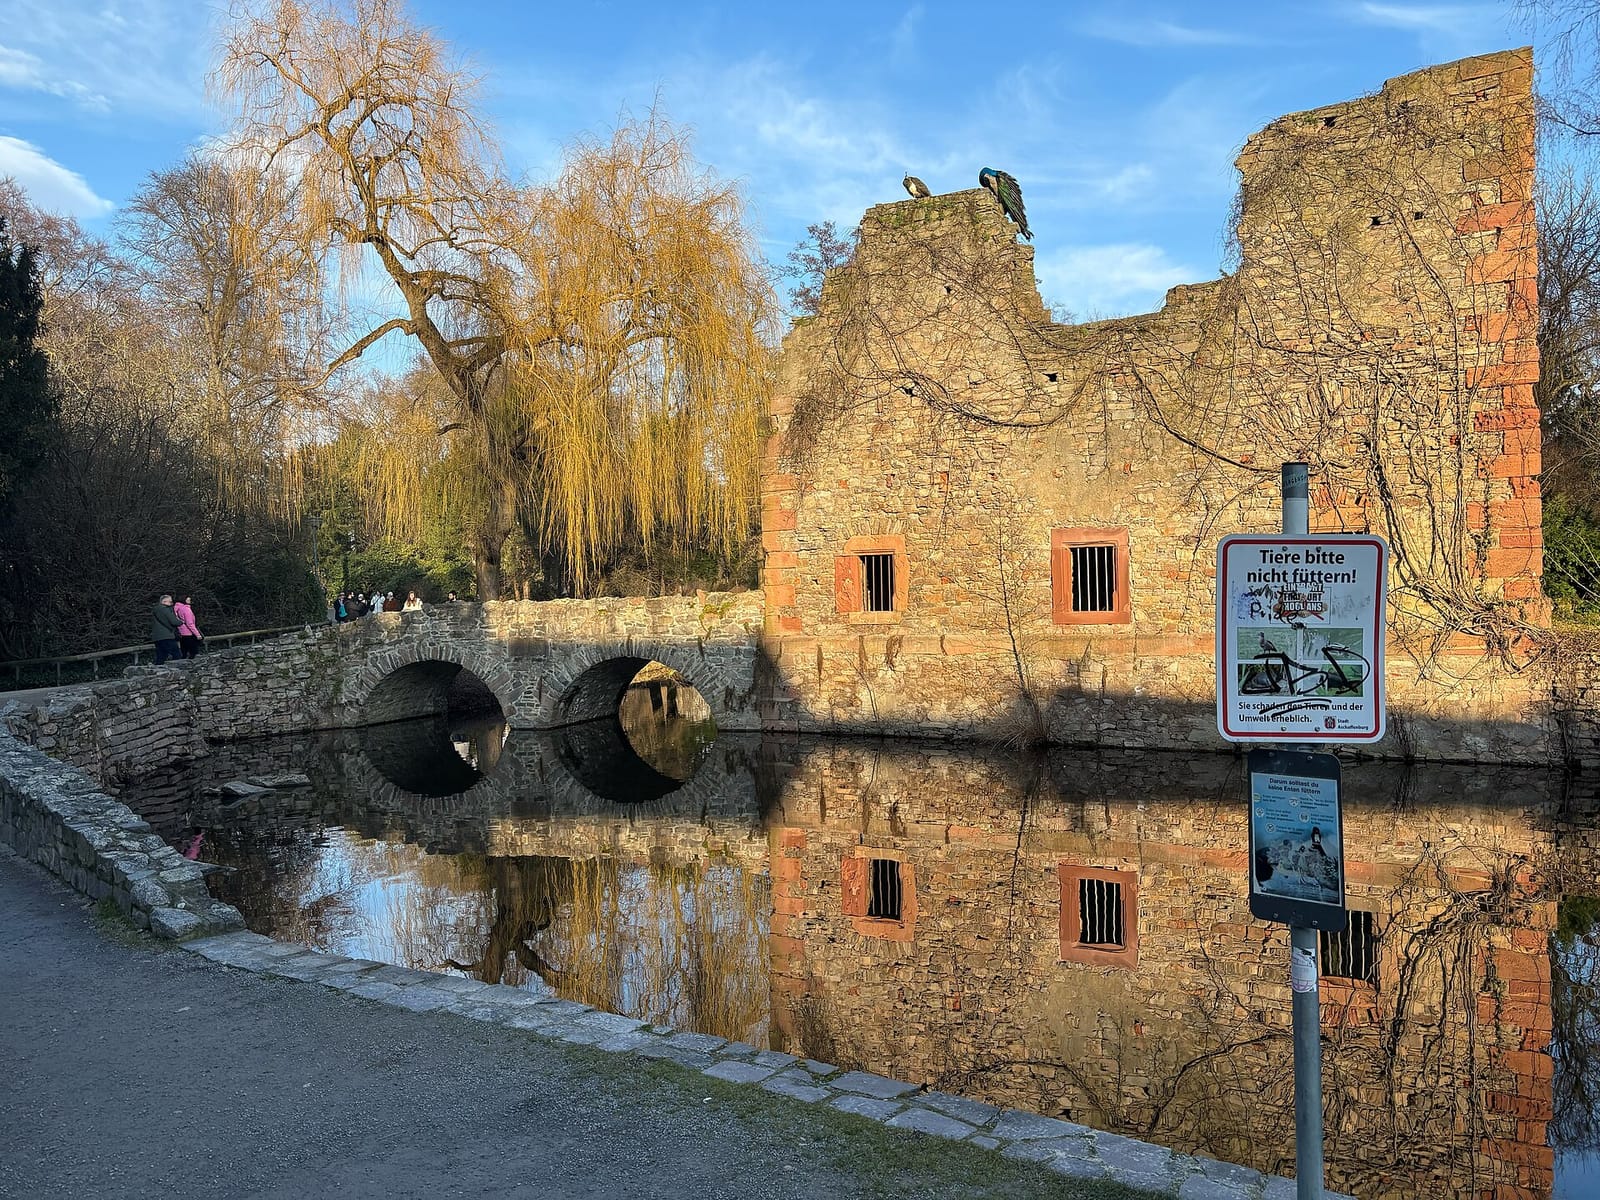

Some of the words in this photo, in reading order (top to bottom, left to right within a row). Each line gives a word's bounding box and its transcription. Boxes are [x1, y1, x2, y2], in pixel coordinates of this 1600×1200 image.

[1260, 549, 1300, 564] Tiere
[1305, 549, 1345, 564] bitte
[1247, 568, 1288, 583] nicht
[1292, 568, 1357, 584] füttern!
[1239, 701, 1251, 710] Sie
[1331, 702, 1347, 711] und
[1349, 702, 1363, 711] der
[1239, 714, 1271, 723] Umwelt
